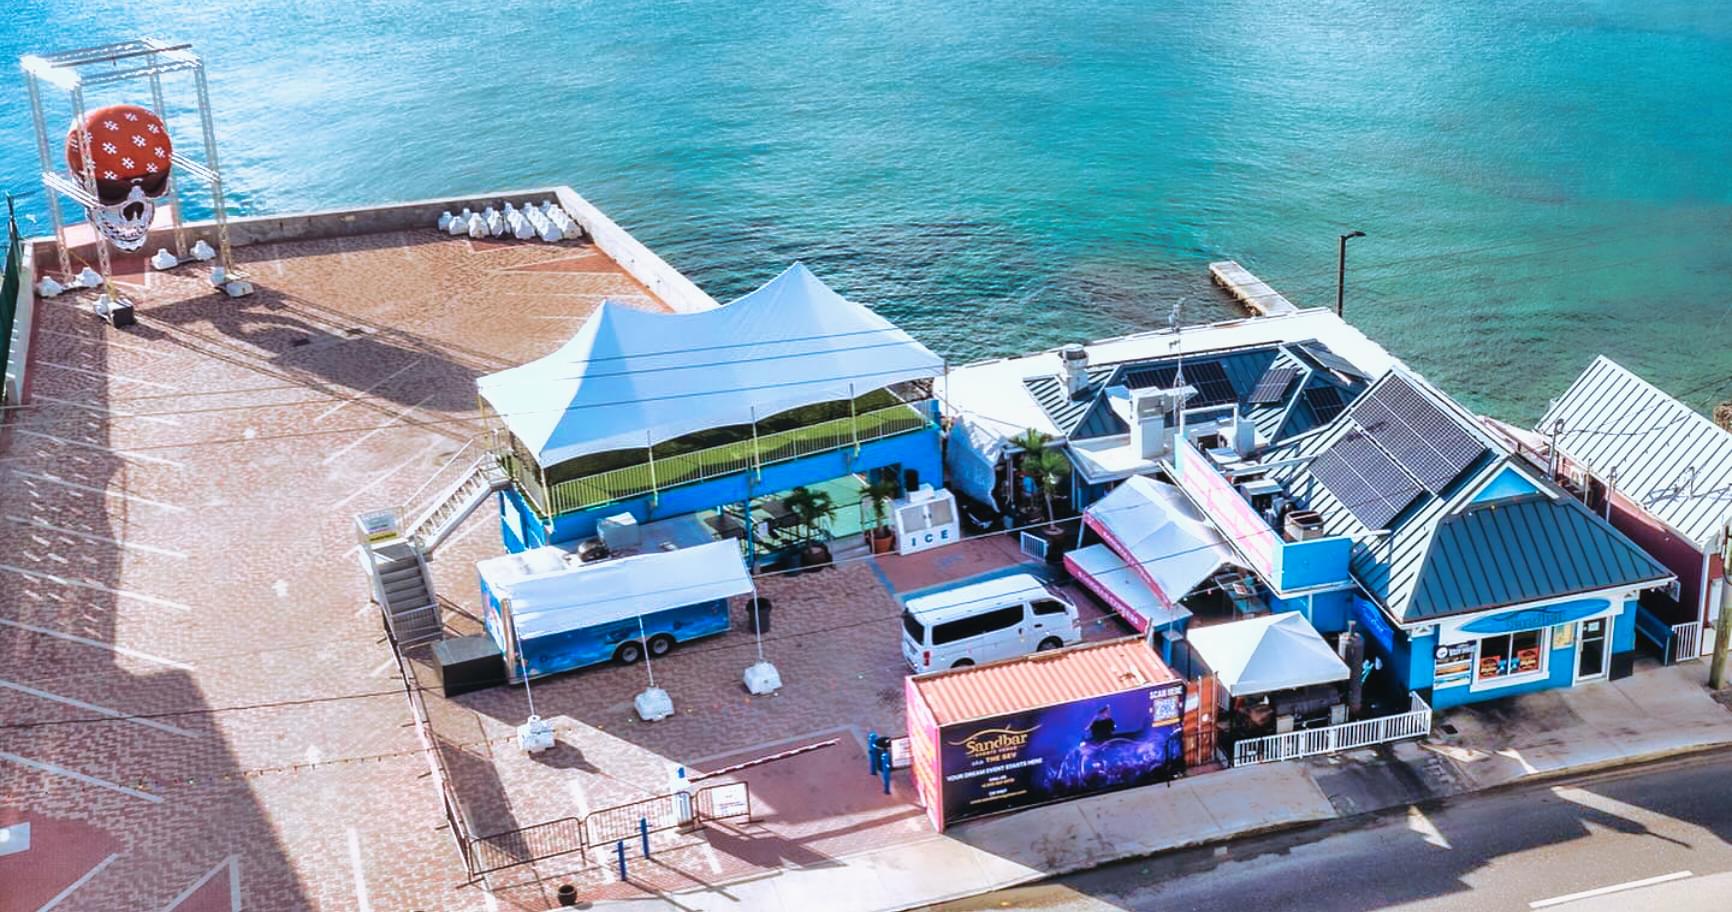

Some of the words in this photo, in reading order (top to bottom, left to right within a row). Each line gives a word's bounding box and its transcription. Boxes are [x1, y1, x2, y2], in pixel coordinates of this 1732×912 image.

[911, 530, 949, 546] ICE
[966, 734, 1028, 754] Sandbar
[946, 773, 964, 782] YOUR
[964, 769, 986, 778] DREAM
[986, 764, 1005, 774] EVENT
[1005, 760, 1027, 770] STARTS
[1027, 757, 1043, 766] HERE
